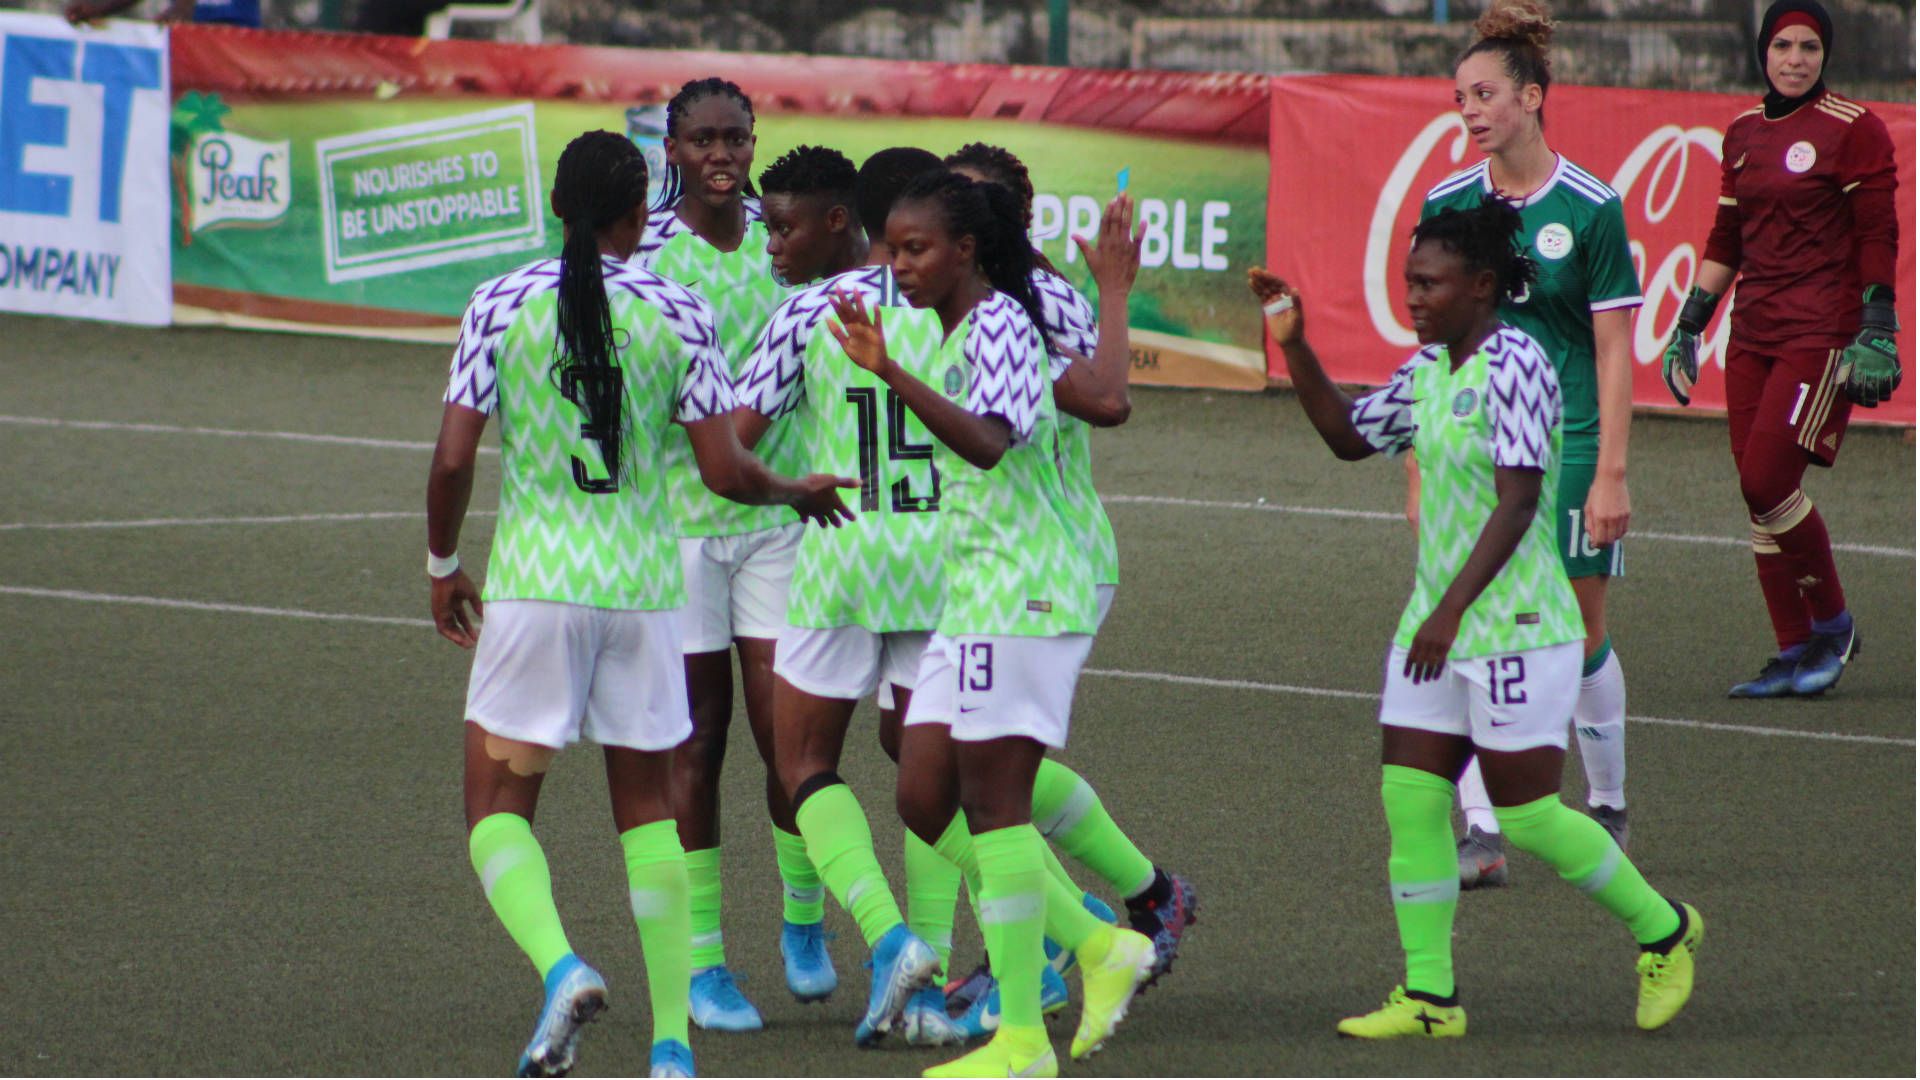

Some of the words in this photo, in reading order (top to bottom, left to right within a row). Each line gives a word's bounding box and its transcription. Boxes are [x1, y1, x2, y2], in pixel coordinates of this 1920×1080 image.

[198, 138, 280, 205] Peak
[353, 155, 466, 198] NOURISHES
[469, 150, 499, 179] TO
[341, 208, 368, 240] BE
[371, 184, 521, 236] UNSTOPPABLE
[1030, 192, 1232, 272] PPBLE
[560, 365, 624, 495] 3
[1789, 382, 1811, 426] 1
[846, 387, 942, 513] 15
[959, 642, 994, 693] 13
[1486, 655, 1528, 705] 12
